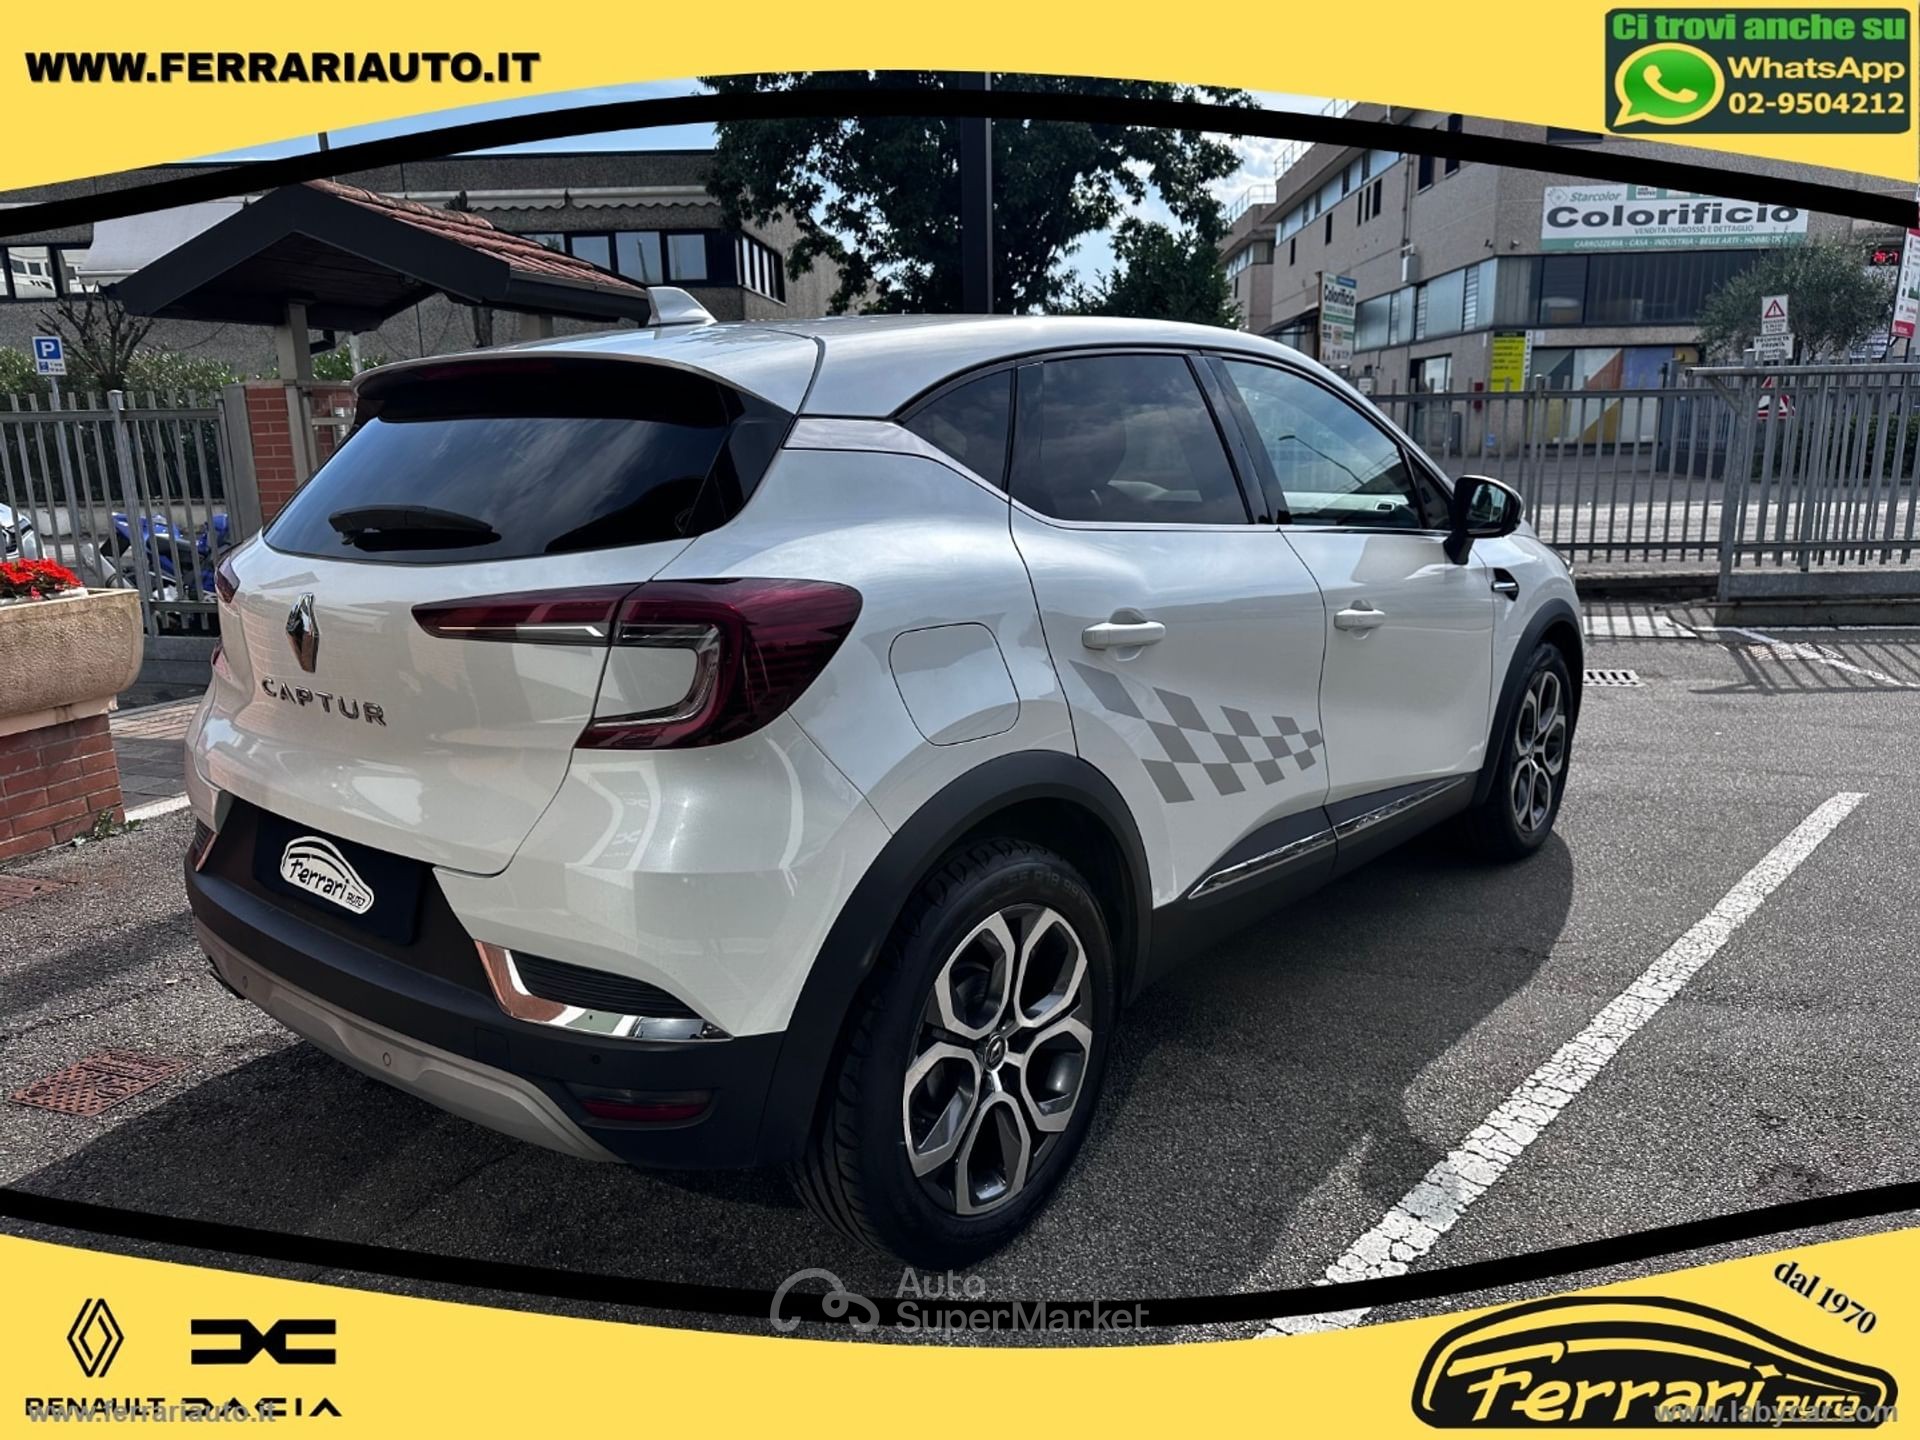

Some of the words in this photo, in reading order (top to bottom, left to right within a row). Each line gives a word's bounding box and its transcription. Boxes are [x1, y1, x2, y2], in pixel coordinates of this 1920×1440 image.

[1569, 190, 1622, 203] Starcolor
[1546, 202, 1800, 228] Colorificio
[1634, 226, 1667, 235] VENDITA
[1667, 225, 1706, 234] INGROSSO
[1713, 224, 1755, 233] DETTAGLIO
[40, 341, 55, 358] P
[261, 677, 387, 727] CAPTUR
